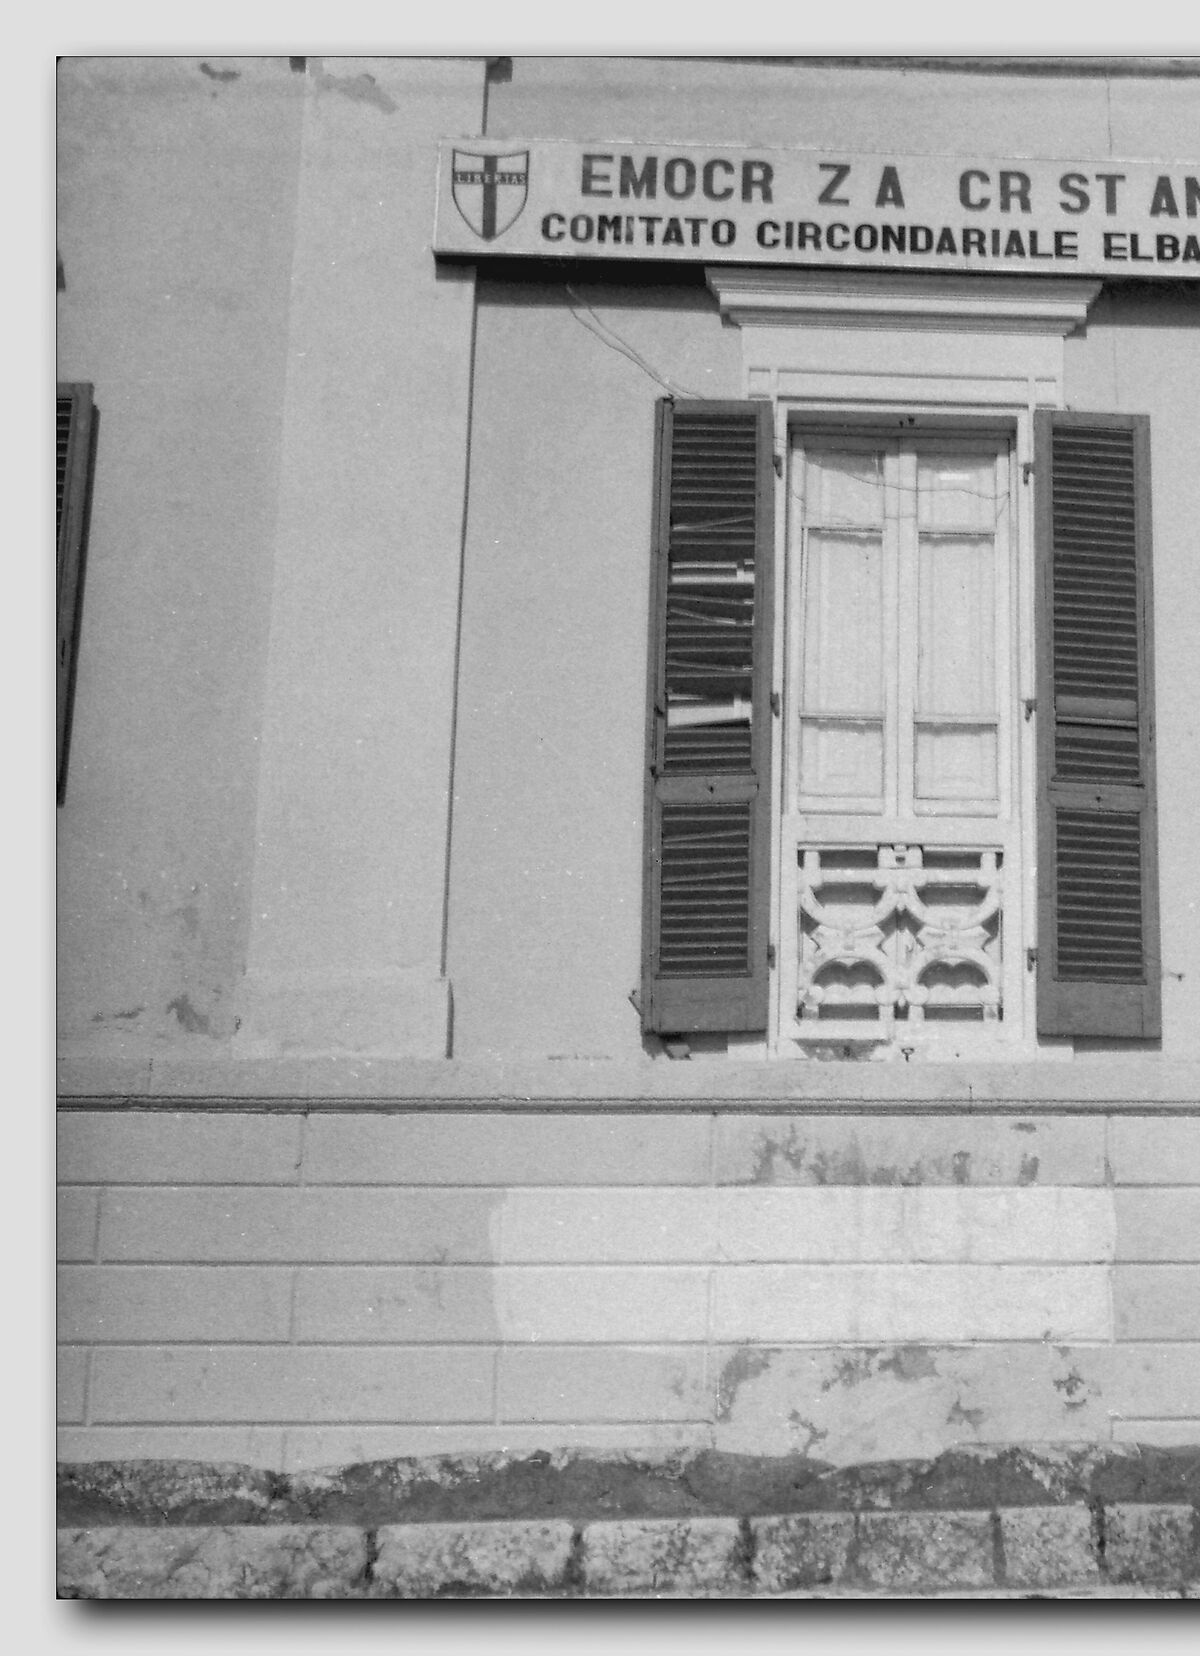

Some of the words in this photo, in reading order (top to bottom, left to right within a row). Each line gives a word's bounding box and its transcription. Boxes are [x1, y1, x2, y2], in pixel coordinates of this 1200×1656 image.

[455, 172, 528, 186] LIBERTAS
[540, 212, 737, 248] COMITATO
[755, 219, 1079, 260] CIRCONDARIALE
